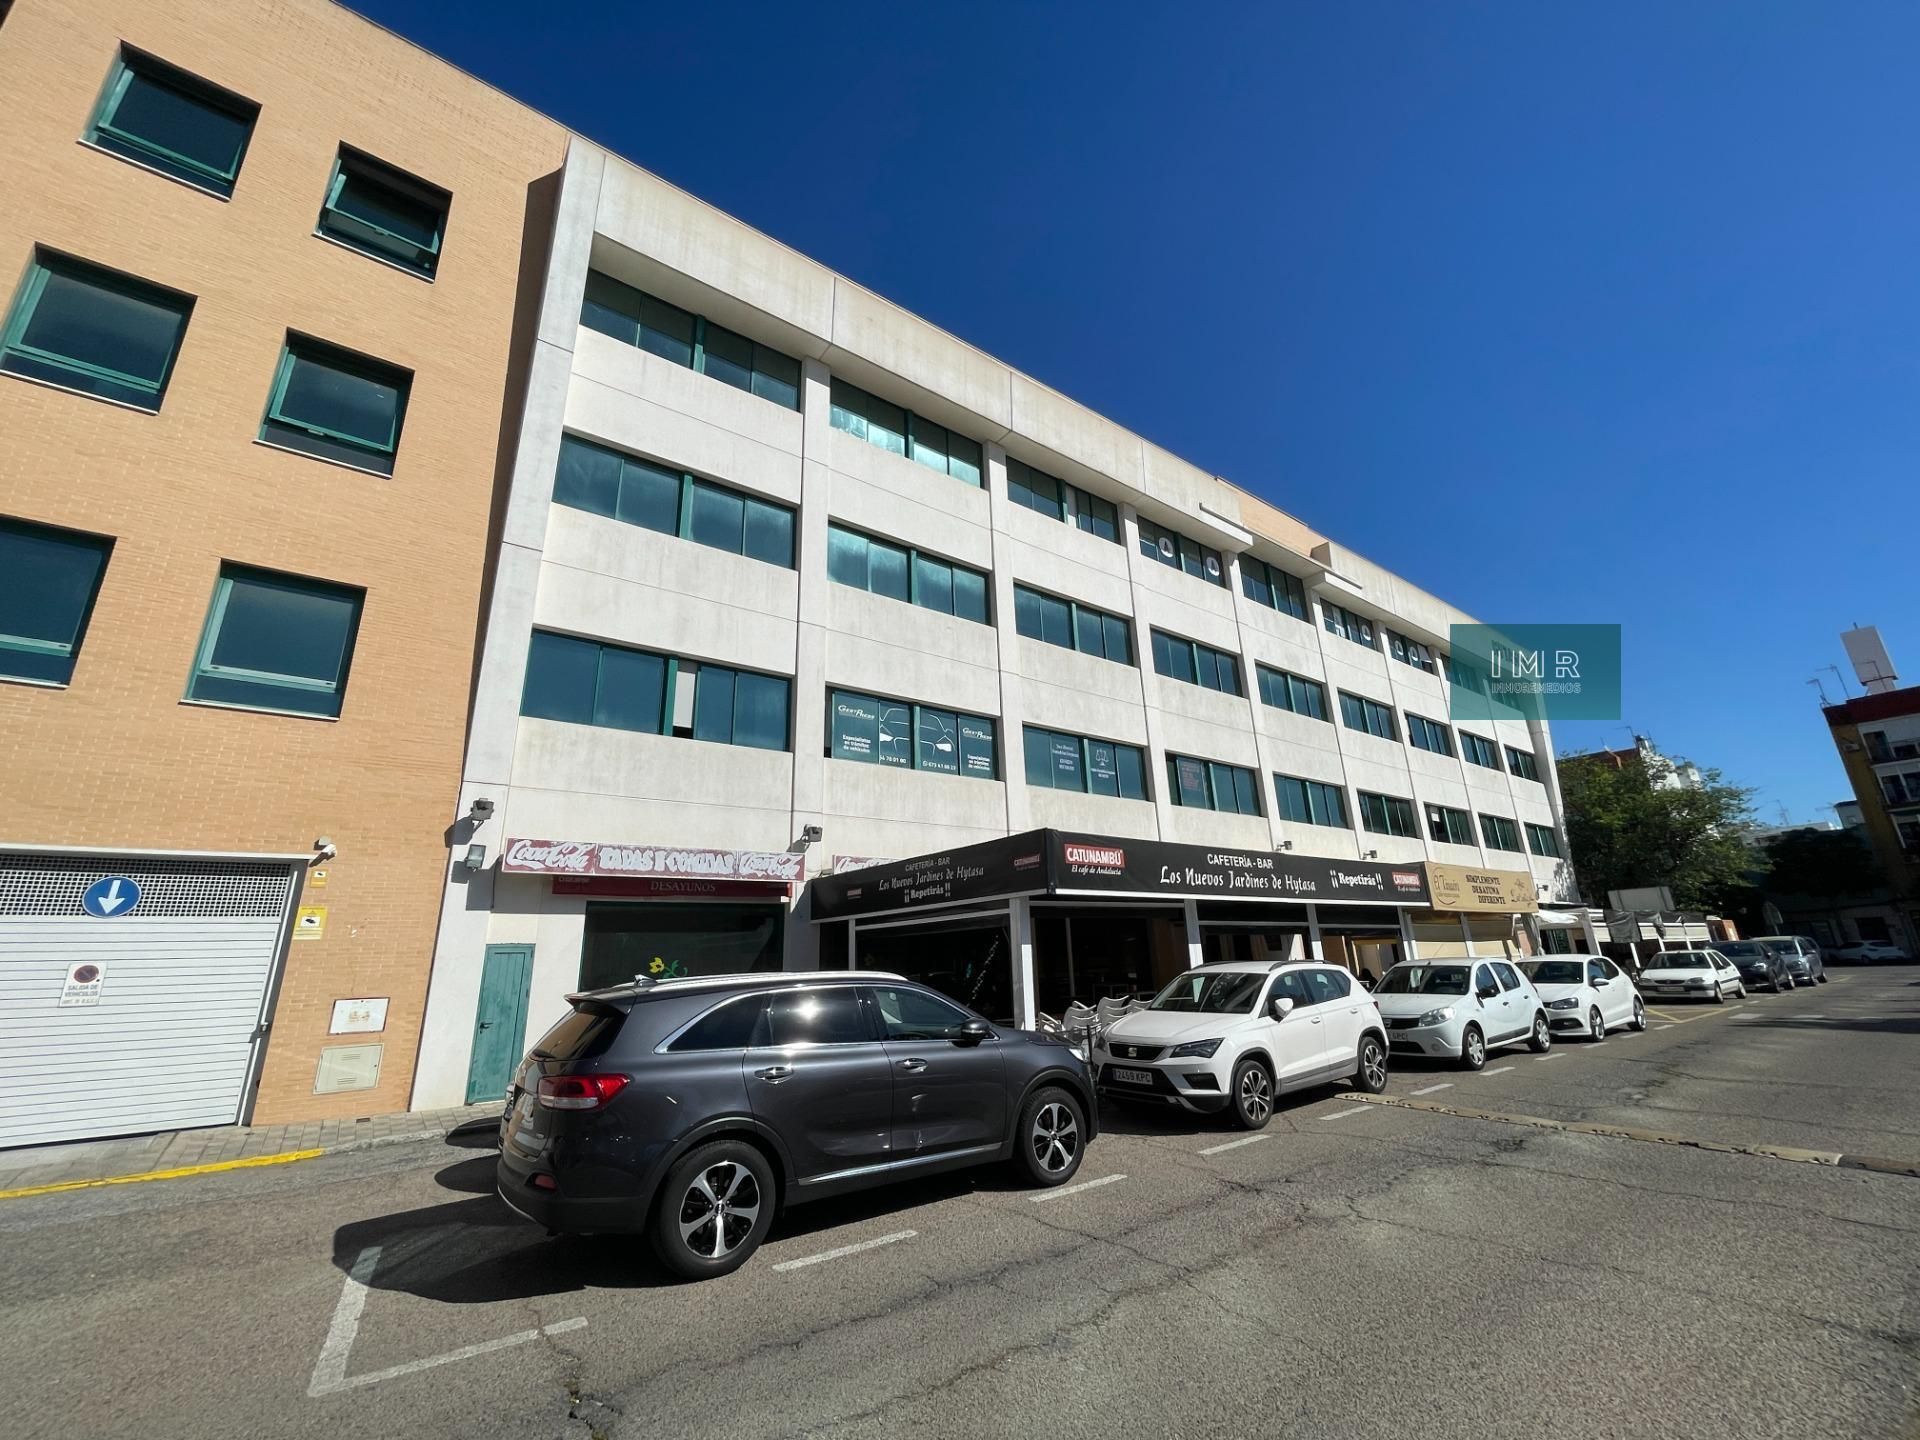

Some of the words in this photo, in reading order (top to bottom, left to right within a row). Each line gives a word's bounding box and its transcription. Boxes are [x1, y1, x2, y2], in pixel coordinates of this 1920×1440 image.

[938, 857, 950, 866] BAR
[1067, 847, 1122, 865] CATUNAMBÚ
[1207, 854, 1252, 867] CAFETERÍA
[1257, 858, 1274, 869] BAR
[651, 880, 716, 892] DESAYUNOS
[879, 880, 889, 891] Los
[916, 871, 943, 885] Jardines
[946, 868, 954, 879] de
[956, 866, 984, 880] Hytasa
[1160, 865, 1181, 884] Los
[1185, 867, 1224, 886] Nuevos
[1228, 870, 1268, 888] Jardines
[1271, 873, 1281, 889] de
[1285, 874, 1316, 894] Hytasa
